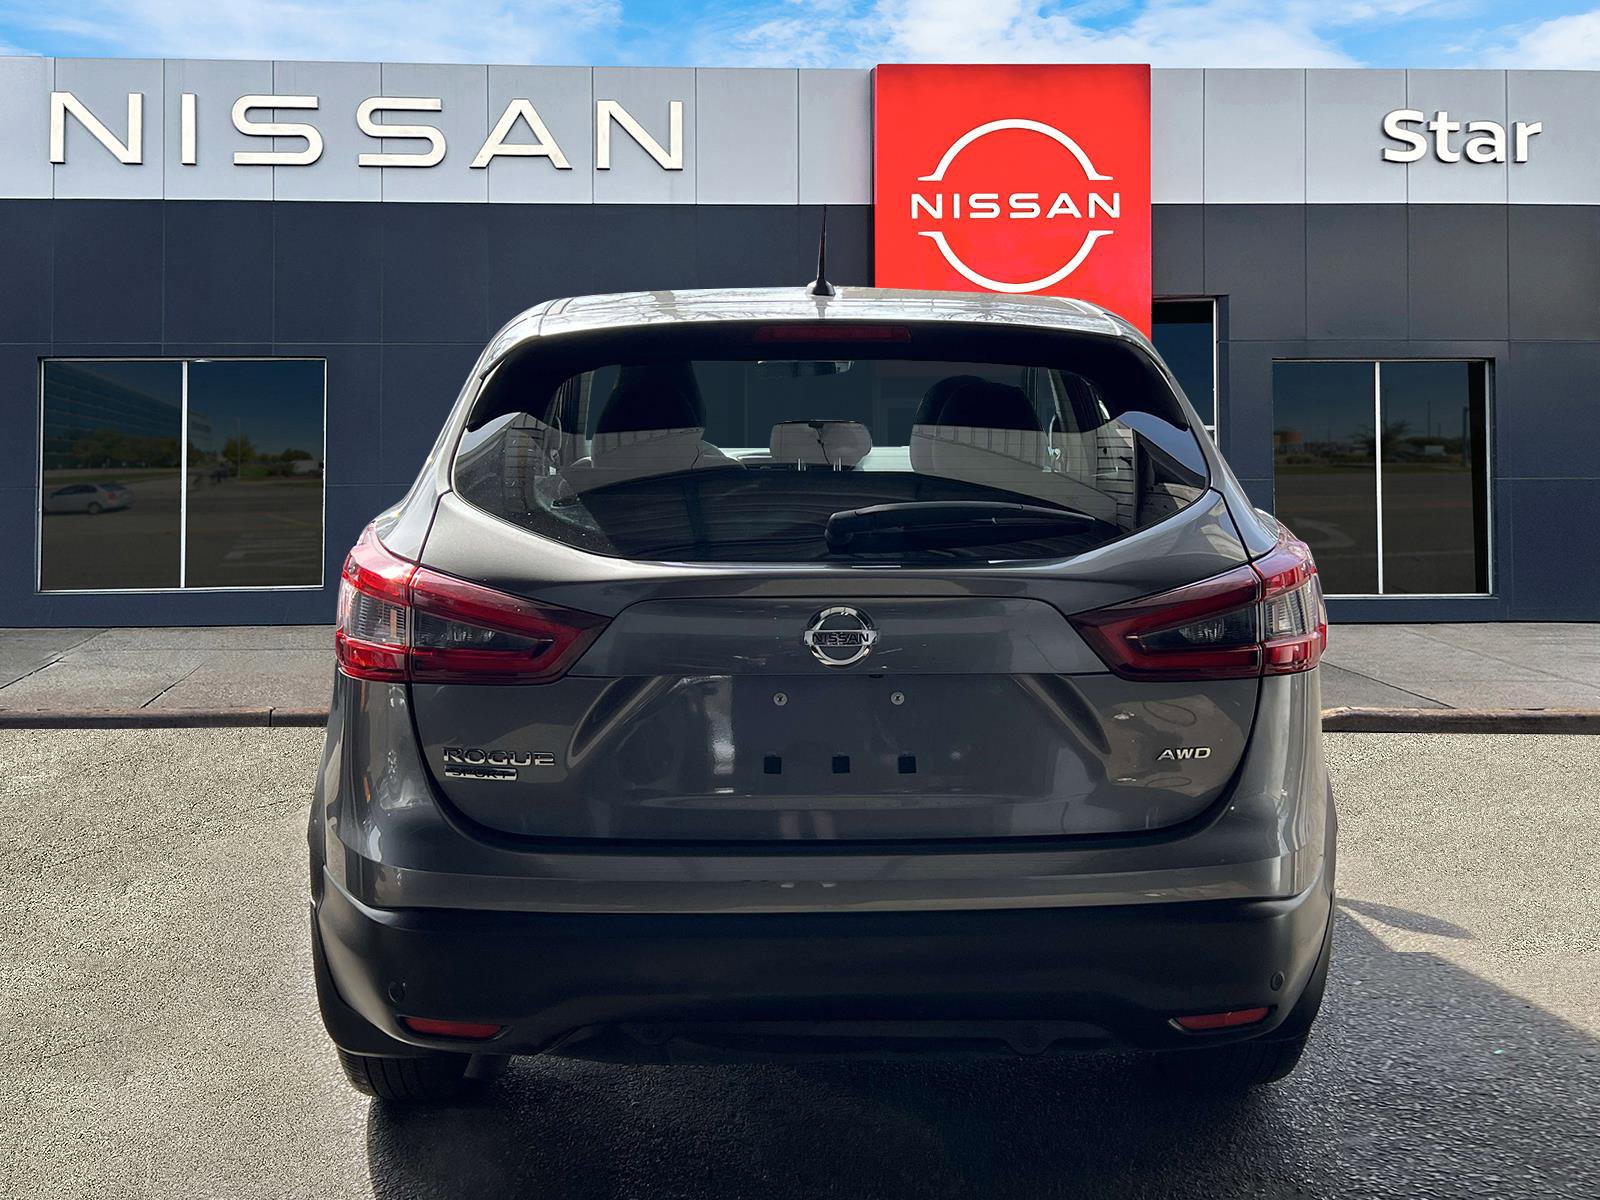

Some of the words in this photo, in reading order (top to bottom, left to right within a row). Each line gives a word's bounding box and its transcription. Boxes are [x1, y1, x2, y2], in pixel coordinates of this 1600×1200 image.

[50, 91, 683, 170] NISSAN
[1383, 109, 1543, 164] Star
[911, 192, 1121, 219] NISSAN
[812, 632, 870, 644] NISSAN
[442, 747, 555, 766] ROGUE
[1157, 747, 1211, 760] AWD
[446, 767, 516, 779] SPORT
